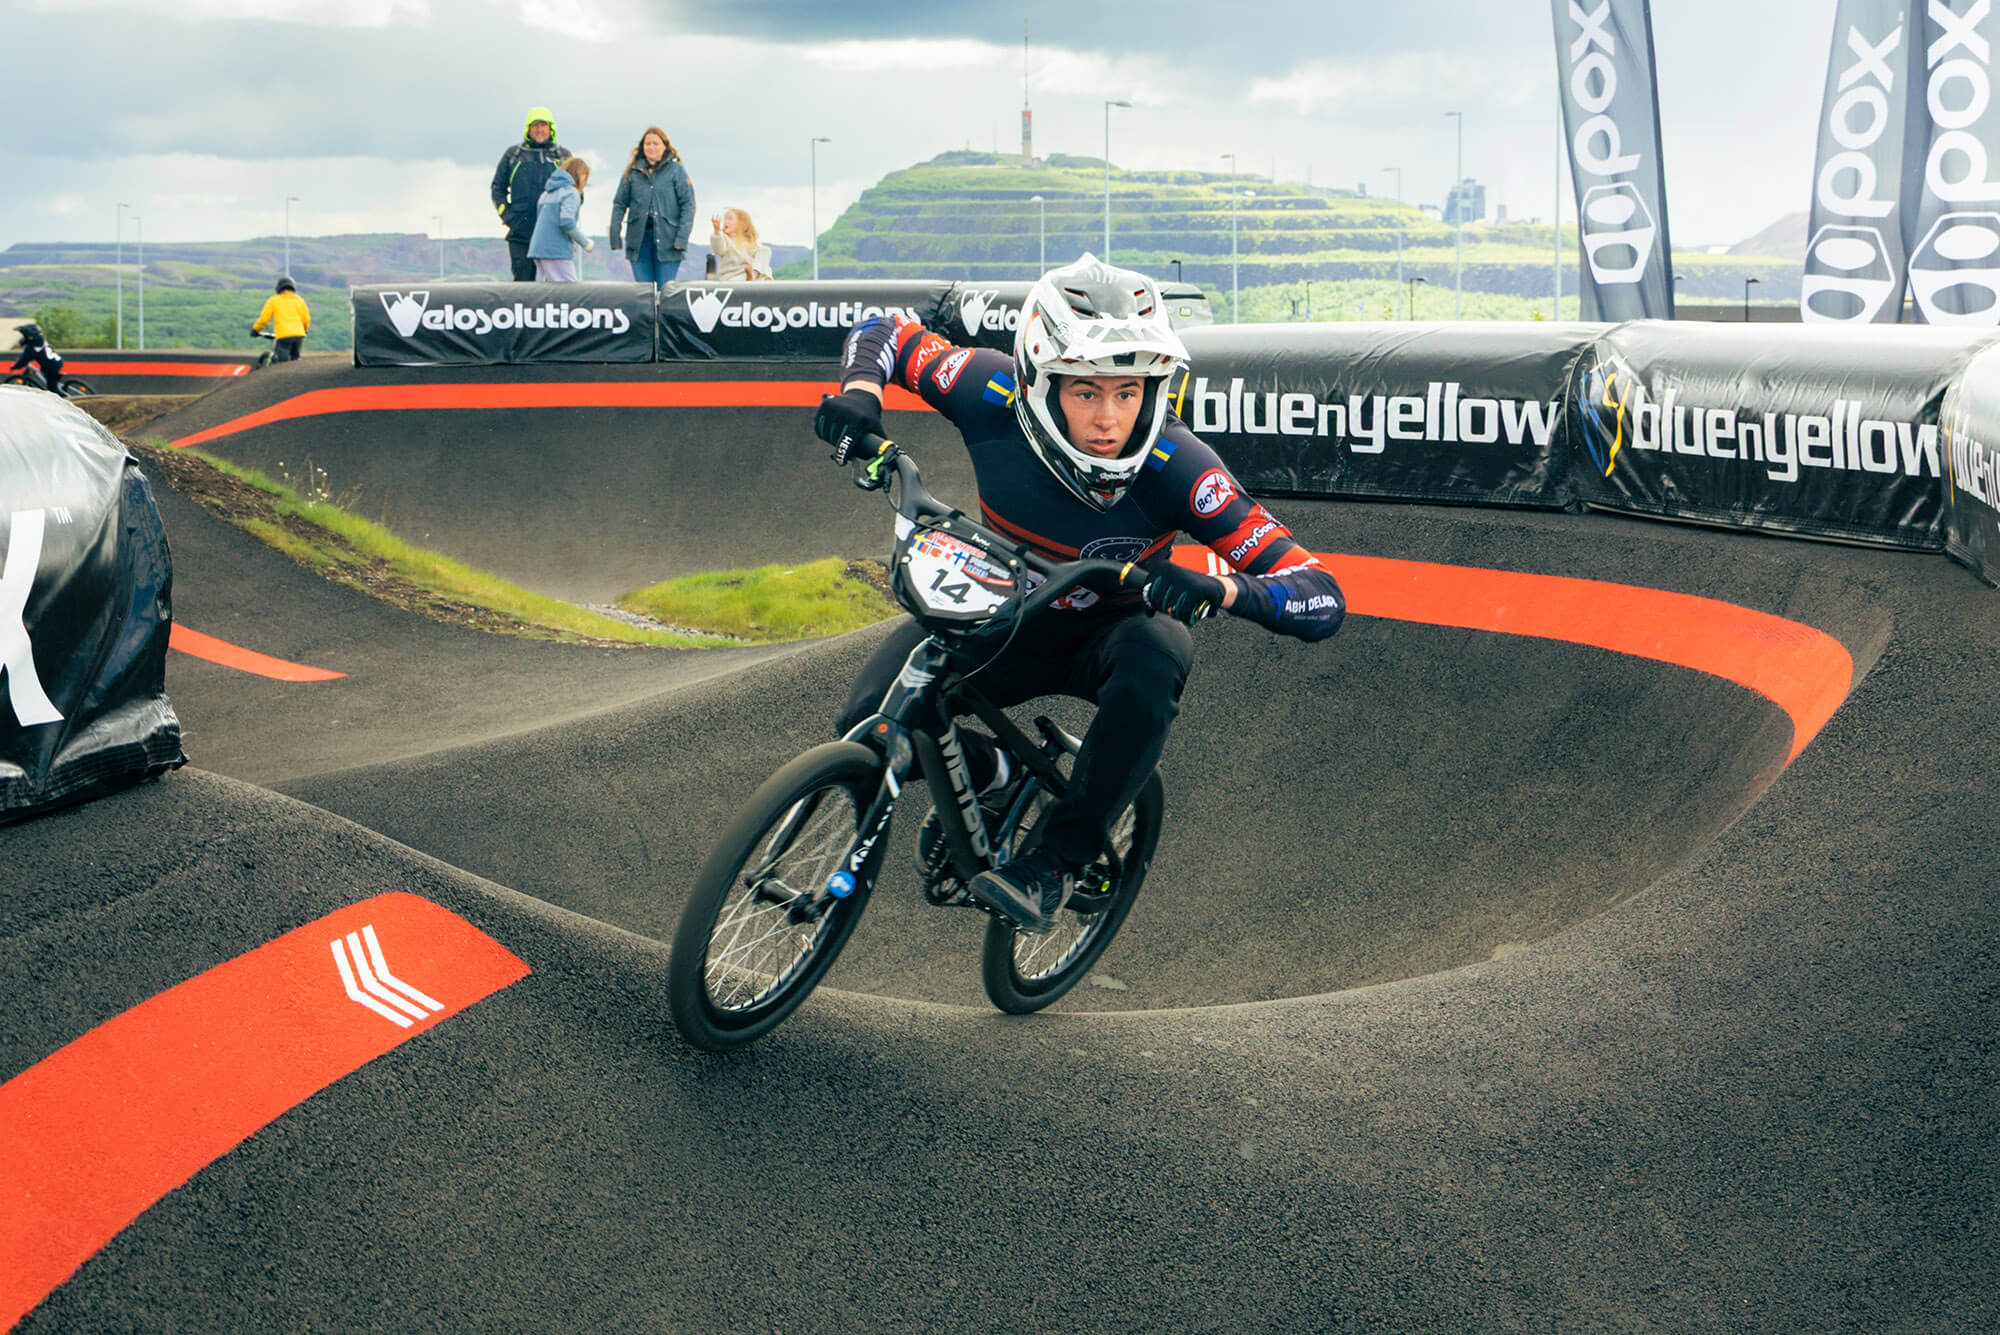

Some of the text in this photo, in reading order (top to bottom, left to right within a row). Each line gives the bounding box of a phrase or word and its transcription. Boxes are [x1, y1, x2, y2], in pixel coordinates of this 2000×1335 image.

[379, 290, 630, 337] Velosolutions
[1194, 377, 1560, 454] bluenyellow
[1631, 385, 1941, 482] bluenyellow
[930, 568, 971, 604] 14
[1285, 600, 1306, 614] ABH
